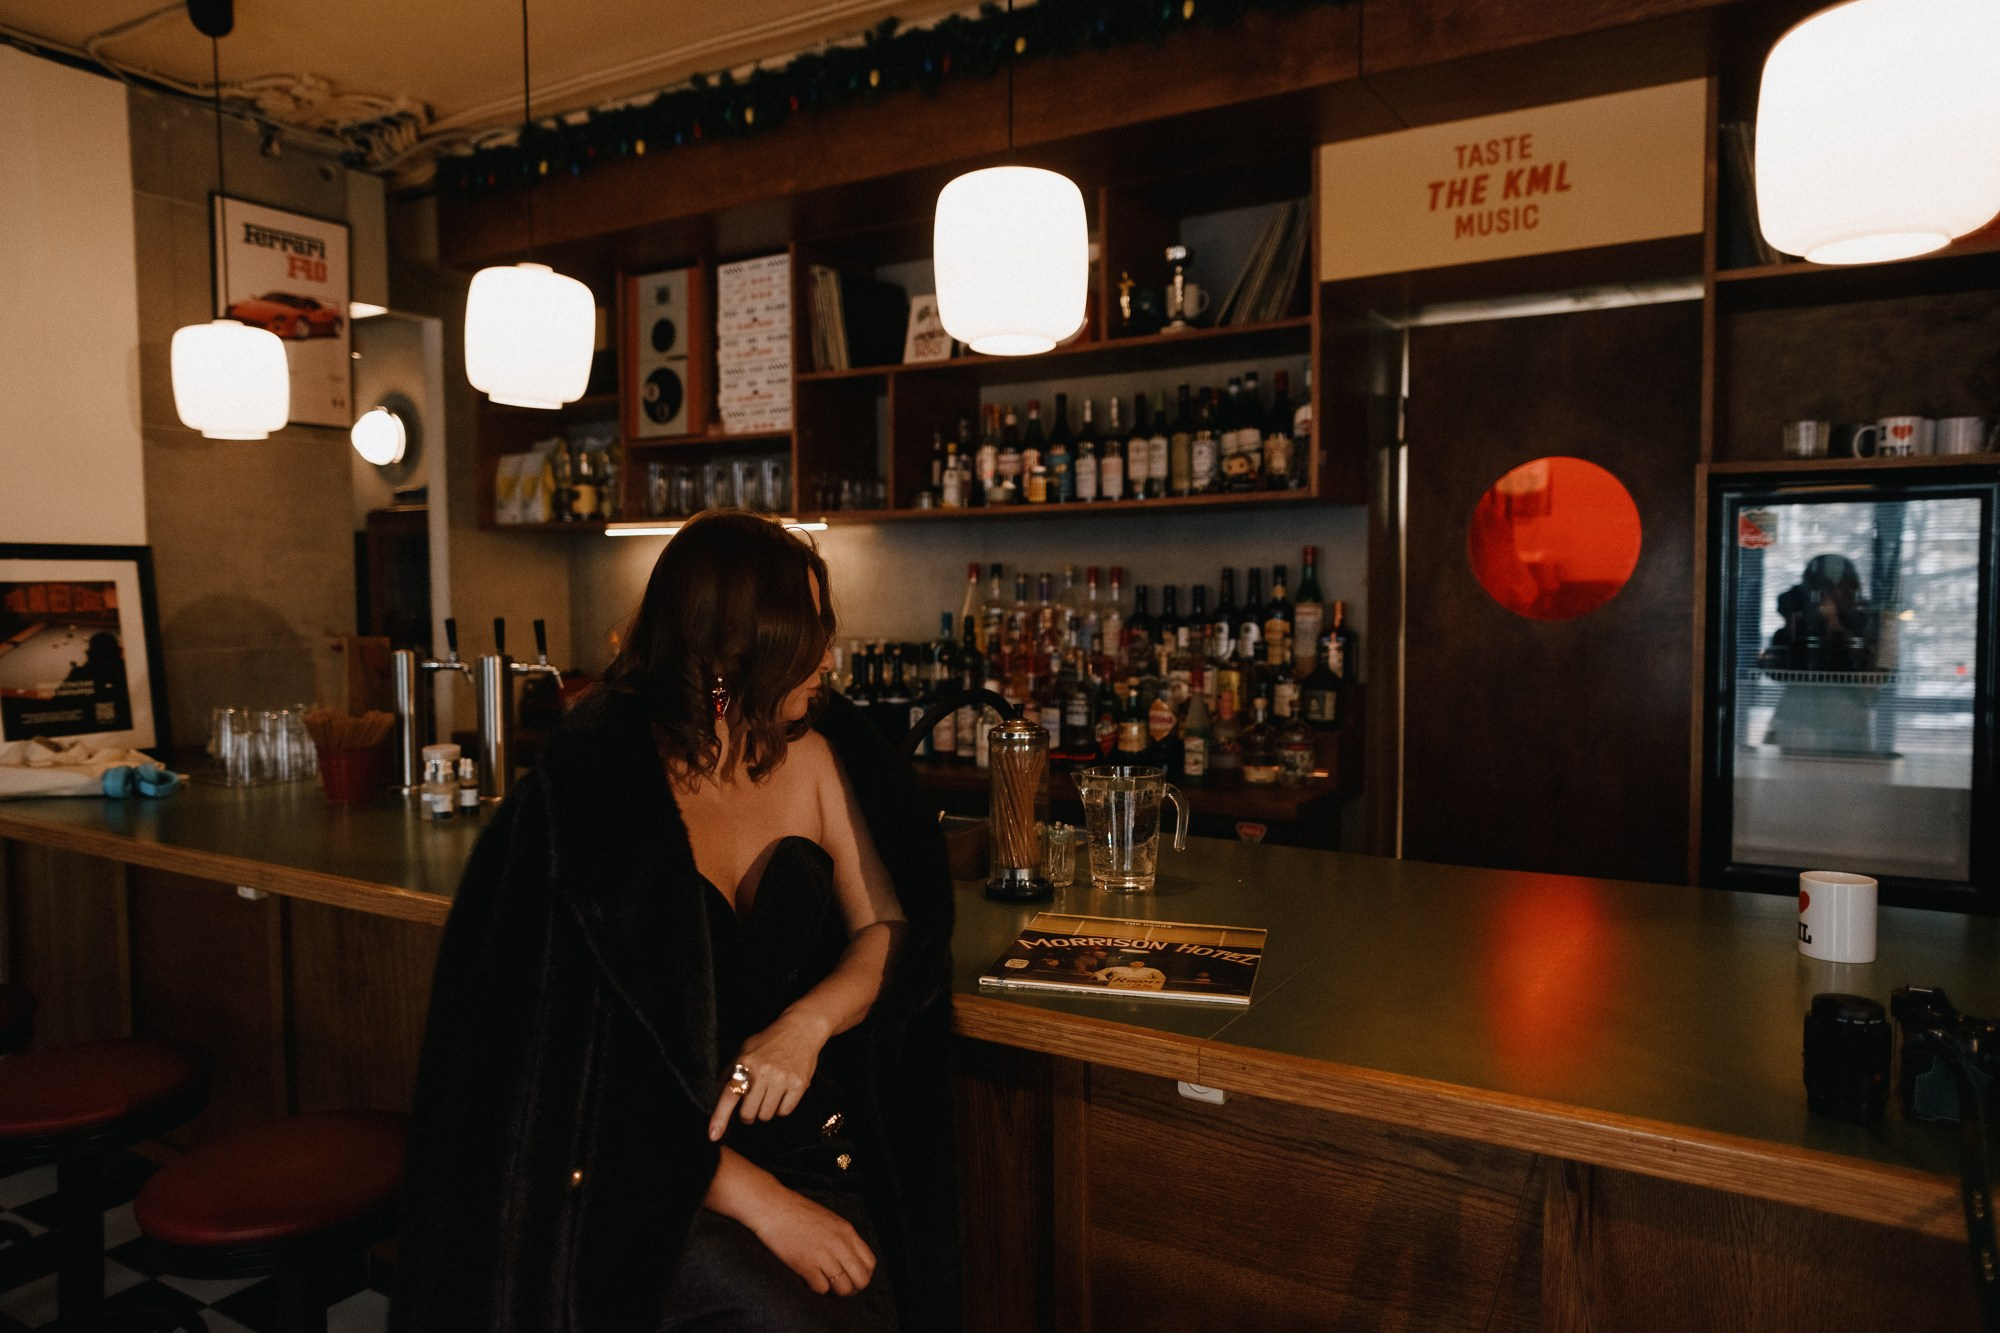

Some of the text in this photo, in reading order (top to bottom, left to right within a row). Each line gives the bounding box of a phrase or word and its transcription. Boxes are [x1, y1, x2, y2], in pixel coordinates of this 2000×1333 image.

[1455, 133, 1533, 170] TASTE
[1428, 161, 1572, 211] THE KML
[243, 222, 325, 259] Ferrari
[1455, 204, 1539, 240] MUSIC
[1017, 937, 1169, 951] MORRISON
